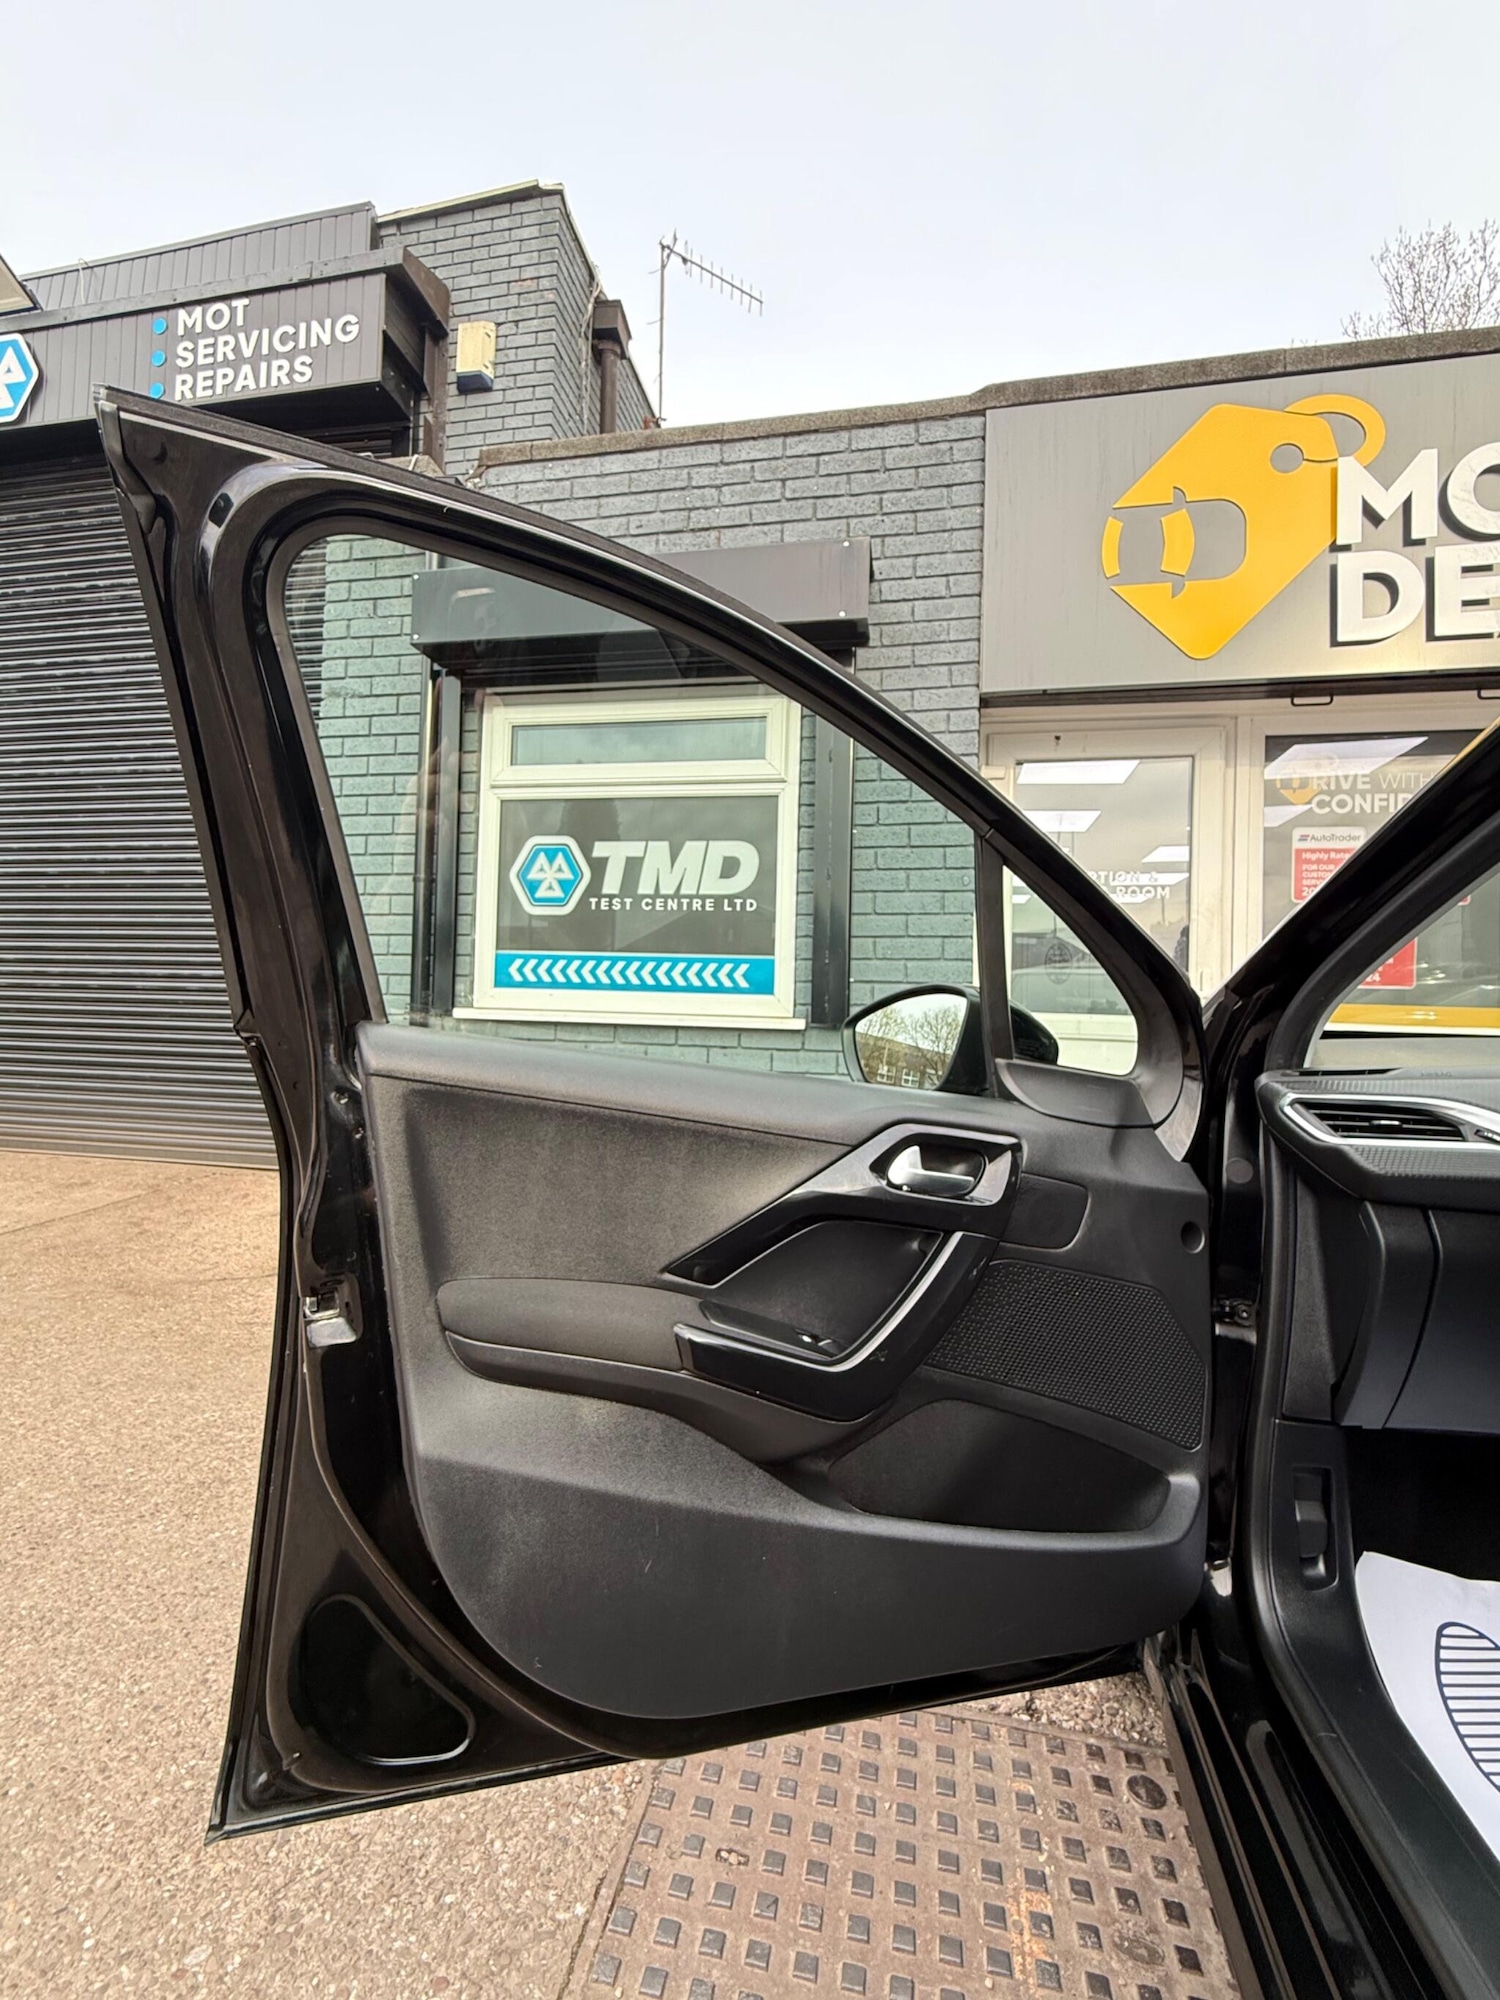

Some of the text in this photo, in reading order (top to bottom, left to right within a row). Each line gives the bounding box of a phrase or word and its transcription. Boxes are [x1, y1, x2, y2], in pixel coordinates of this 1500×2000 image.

[176, 298, 250, 336] MOT
[175, 314, 360, 368] SERVICING
[174, 355, 314, 401] REPAIRS
[1309, 833, 1361, 842] AutoTrader
[1302, 851, 1329, 861] Highly
[591, 840, 760, 895] TMD
[1302, 863, 1336, 871] FOR OUR
[1116, 886, 1170, 899] ROOM
[589, 898, 758, 911] TEST CENTRE LTD
